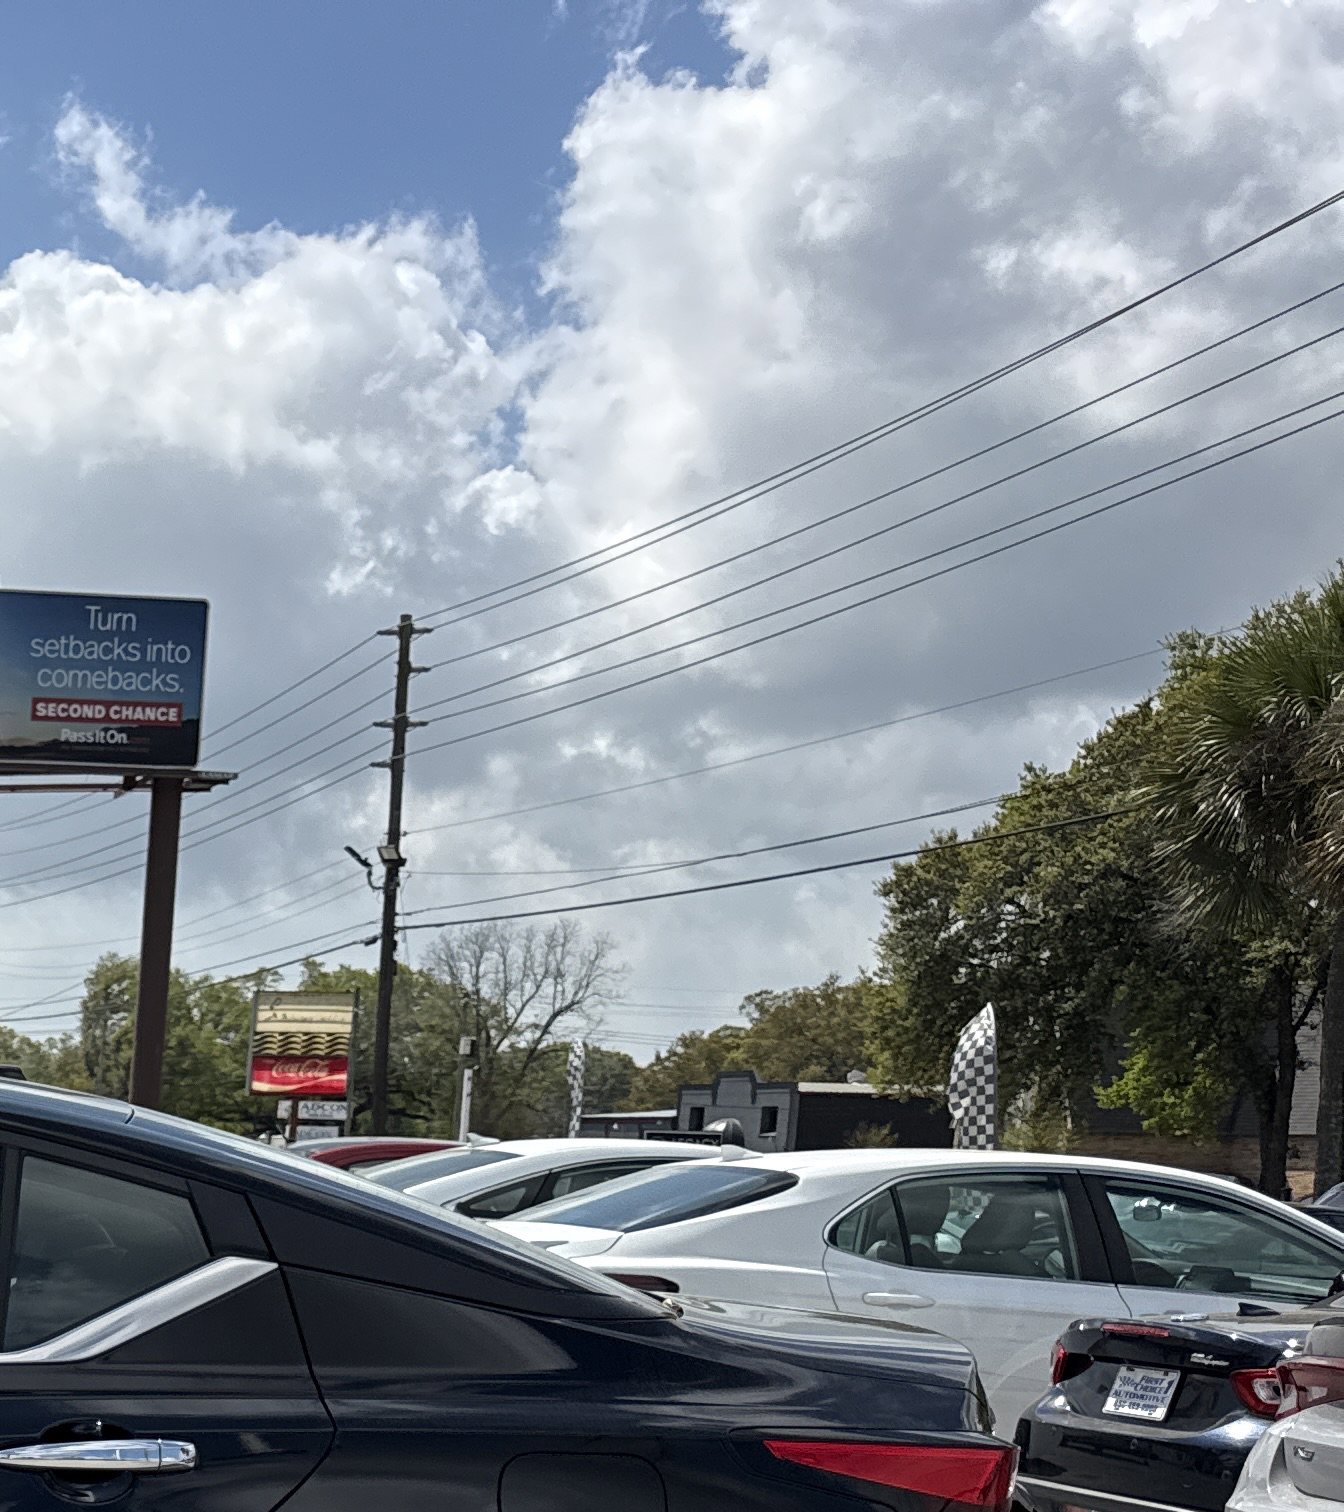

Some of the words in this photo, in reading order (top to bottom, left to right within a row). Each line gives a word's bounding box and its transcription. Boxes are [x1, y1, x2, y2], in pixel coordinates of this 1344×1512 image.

[85, 605, 137, 632] Turn
[30, 636, 142, 663] setbacks
[146, 637, 192, 665] into
[36, 666, 185, 694] comebacks.
[35, 702, 105, 720] SECOND
[109, 704, 178, 722] CHANCE
